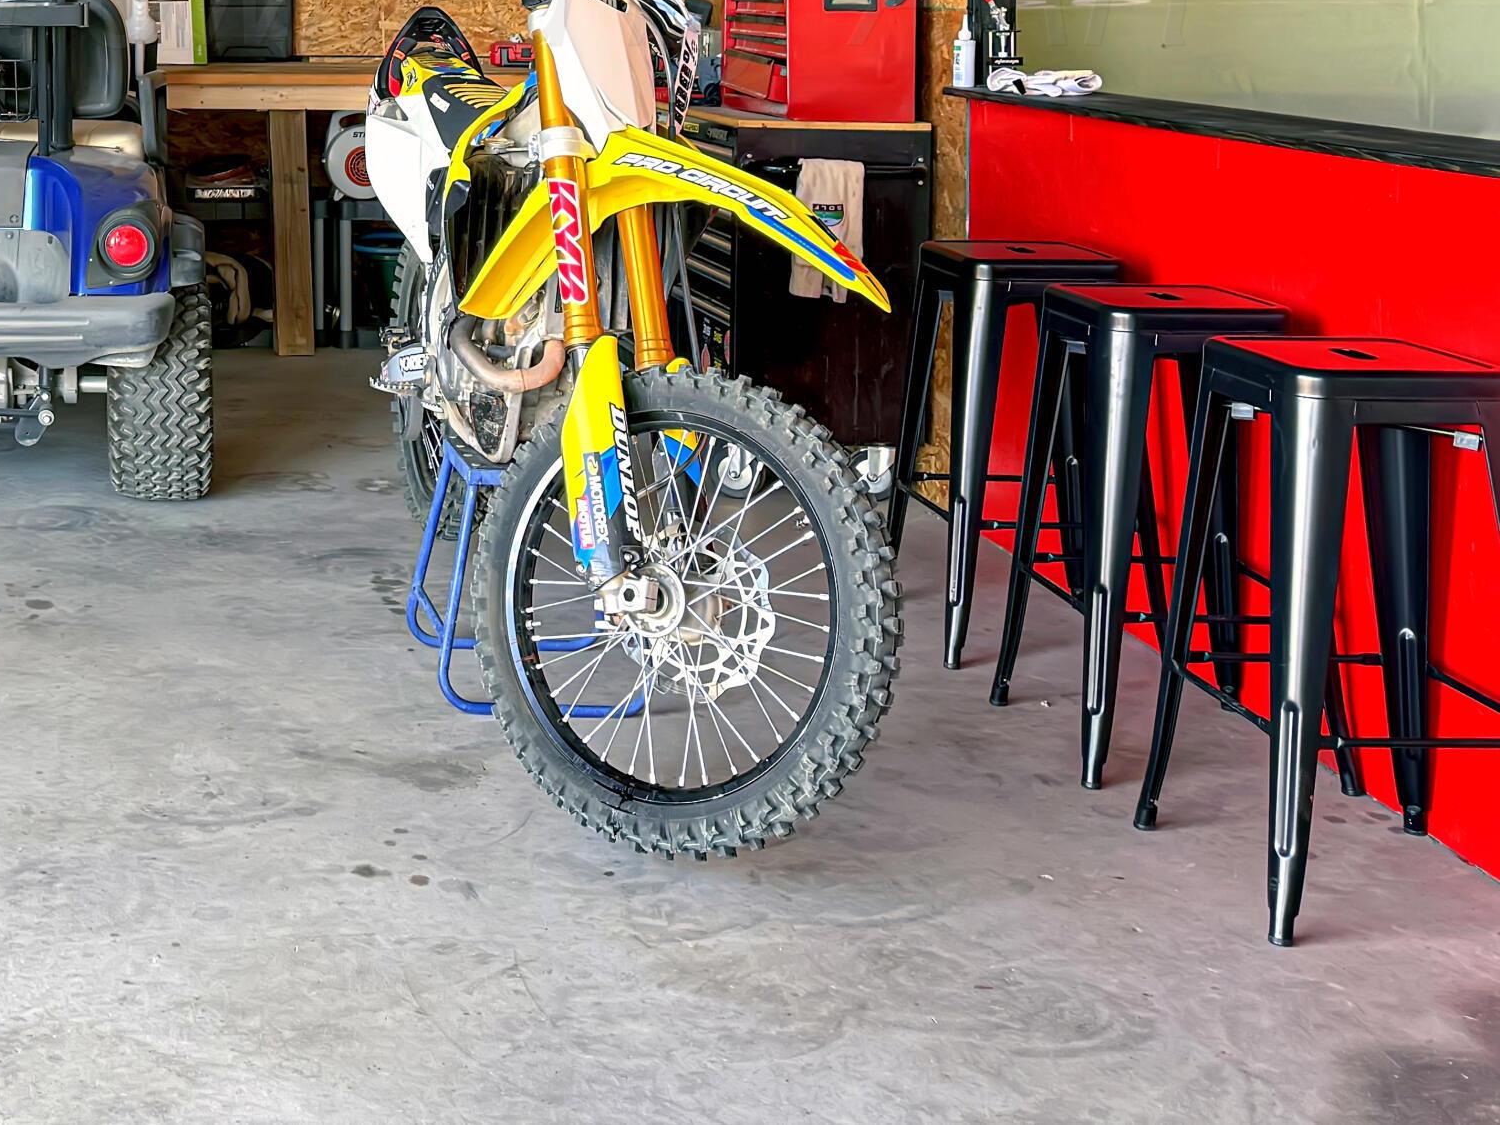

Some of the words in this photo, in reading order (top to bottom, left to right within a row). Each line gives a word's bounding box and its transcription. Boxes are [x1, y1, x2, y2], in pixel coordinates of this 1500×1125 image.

[613, 153, 684, 175] PRO
[676, 168, 792, 220] CIRCUIT
[549, 181, 587, 304] KYB
[609, 403, 642, 543] DUNLOP
[576, 498, 594, 548] MOTUL
[589, 476, 610, 544] MOTOREX
